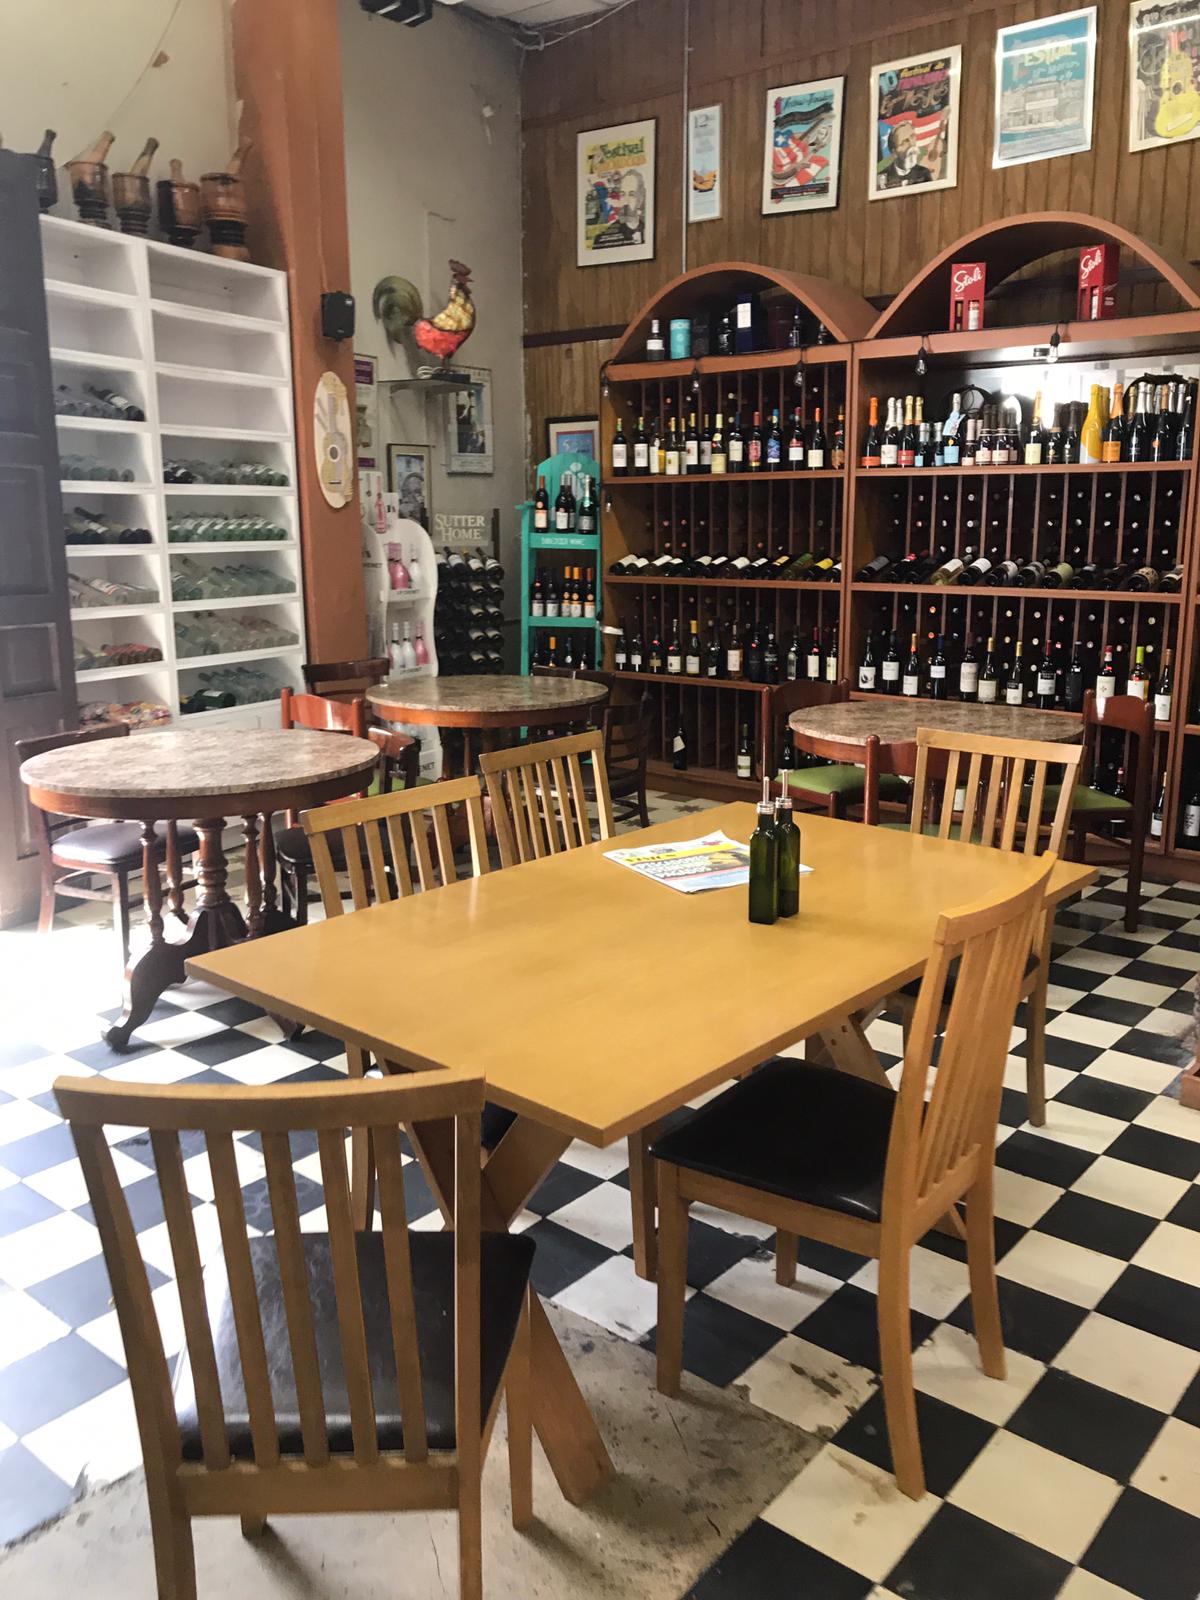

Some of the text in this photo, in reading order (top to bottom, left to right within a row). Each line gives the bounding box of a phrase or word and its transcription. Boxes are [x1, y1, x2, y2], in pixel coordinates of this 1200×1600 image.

[1080, 248, 1102, 280] Stoli
[953, 266, 983, 293] Stoli
[435, 513, 486, 530] SUTTER
[441, 528, 482, 541] HOME
